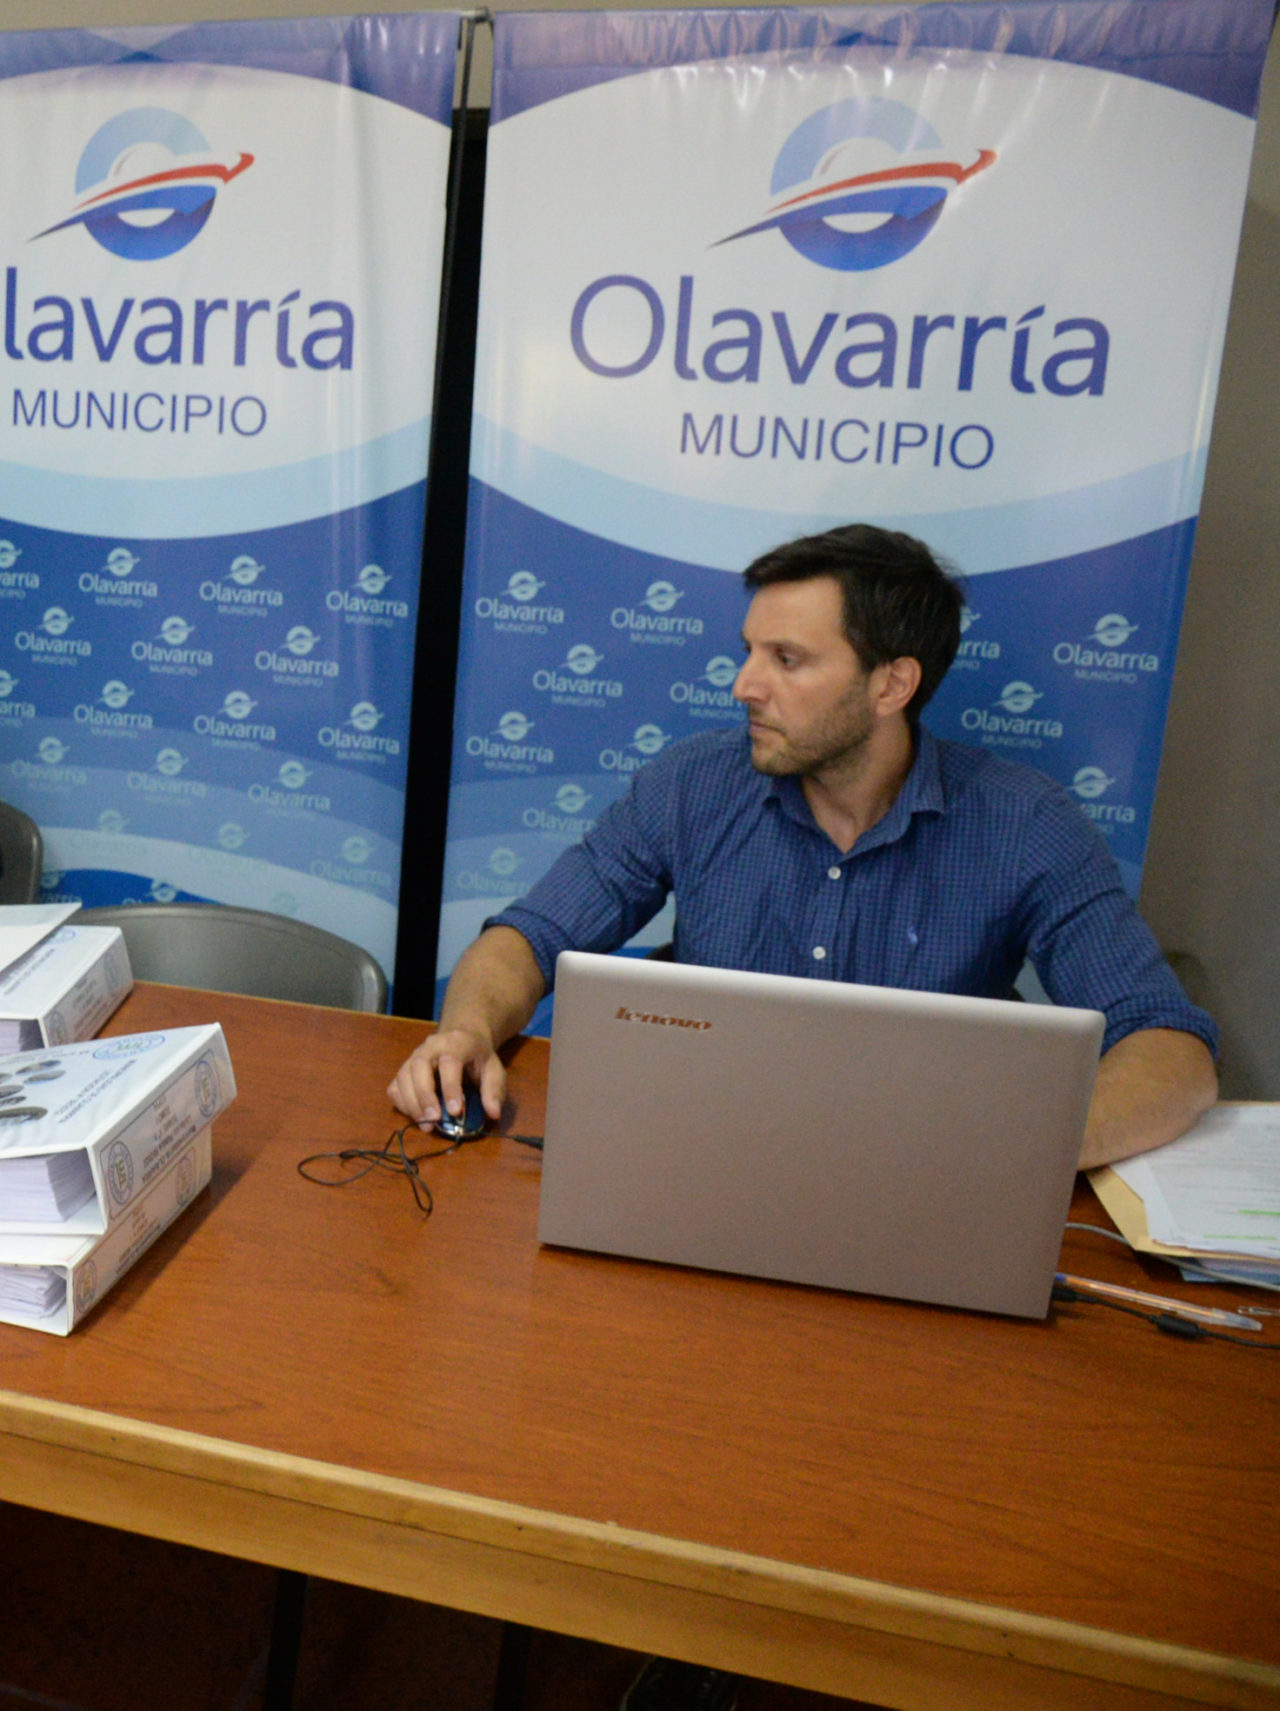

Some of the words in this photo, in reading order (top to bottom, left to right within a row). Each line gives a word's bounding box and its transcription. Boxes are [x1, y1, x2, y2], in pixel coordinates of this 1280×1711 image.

[570, 273, 1112, 397] Olavarría
[12, 389, 268, 436] MUNICIPIO
[679, 412, 995, 470] MUNICIPIO
[615, 1006, 713, 1031] lenovo
